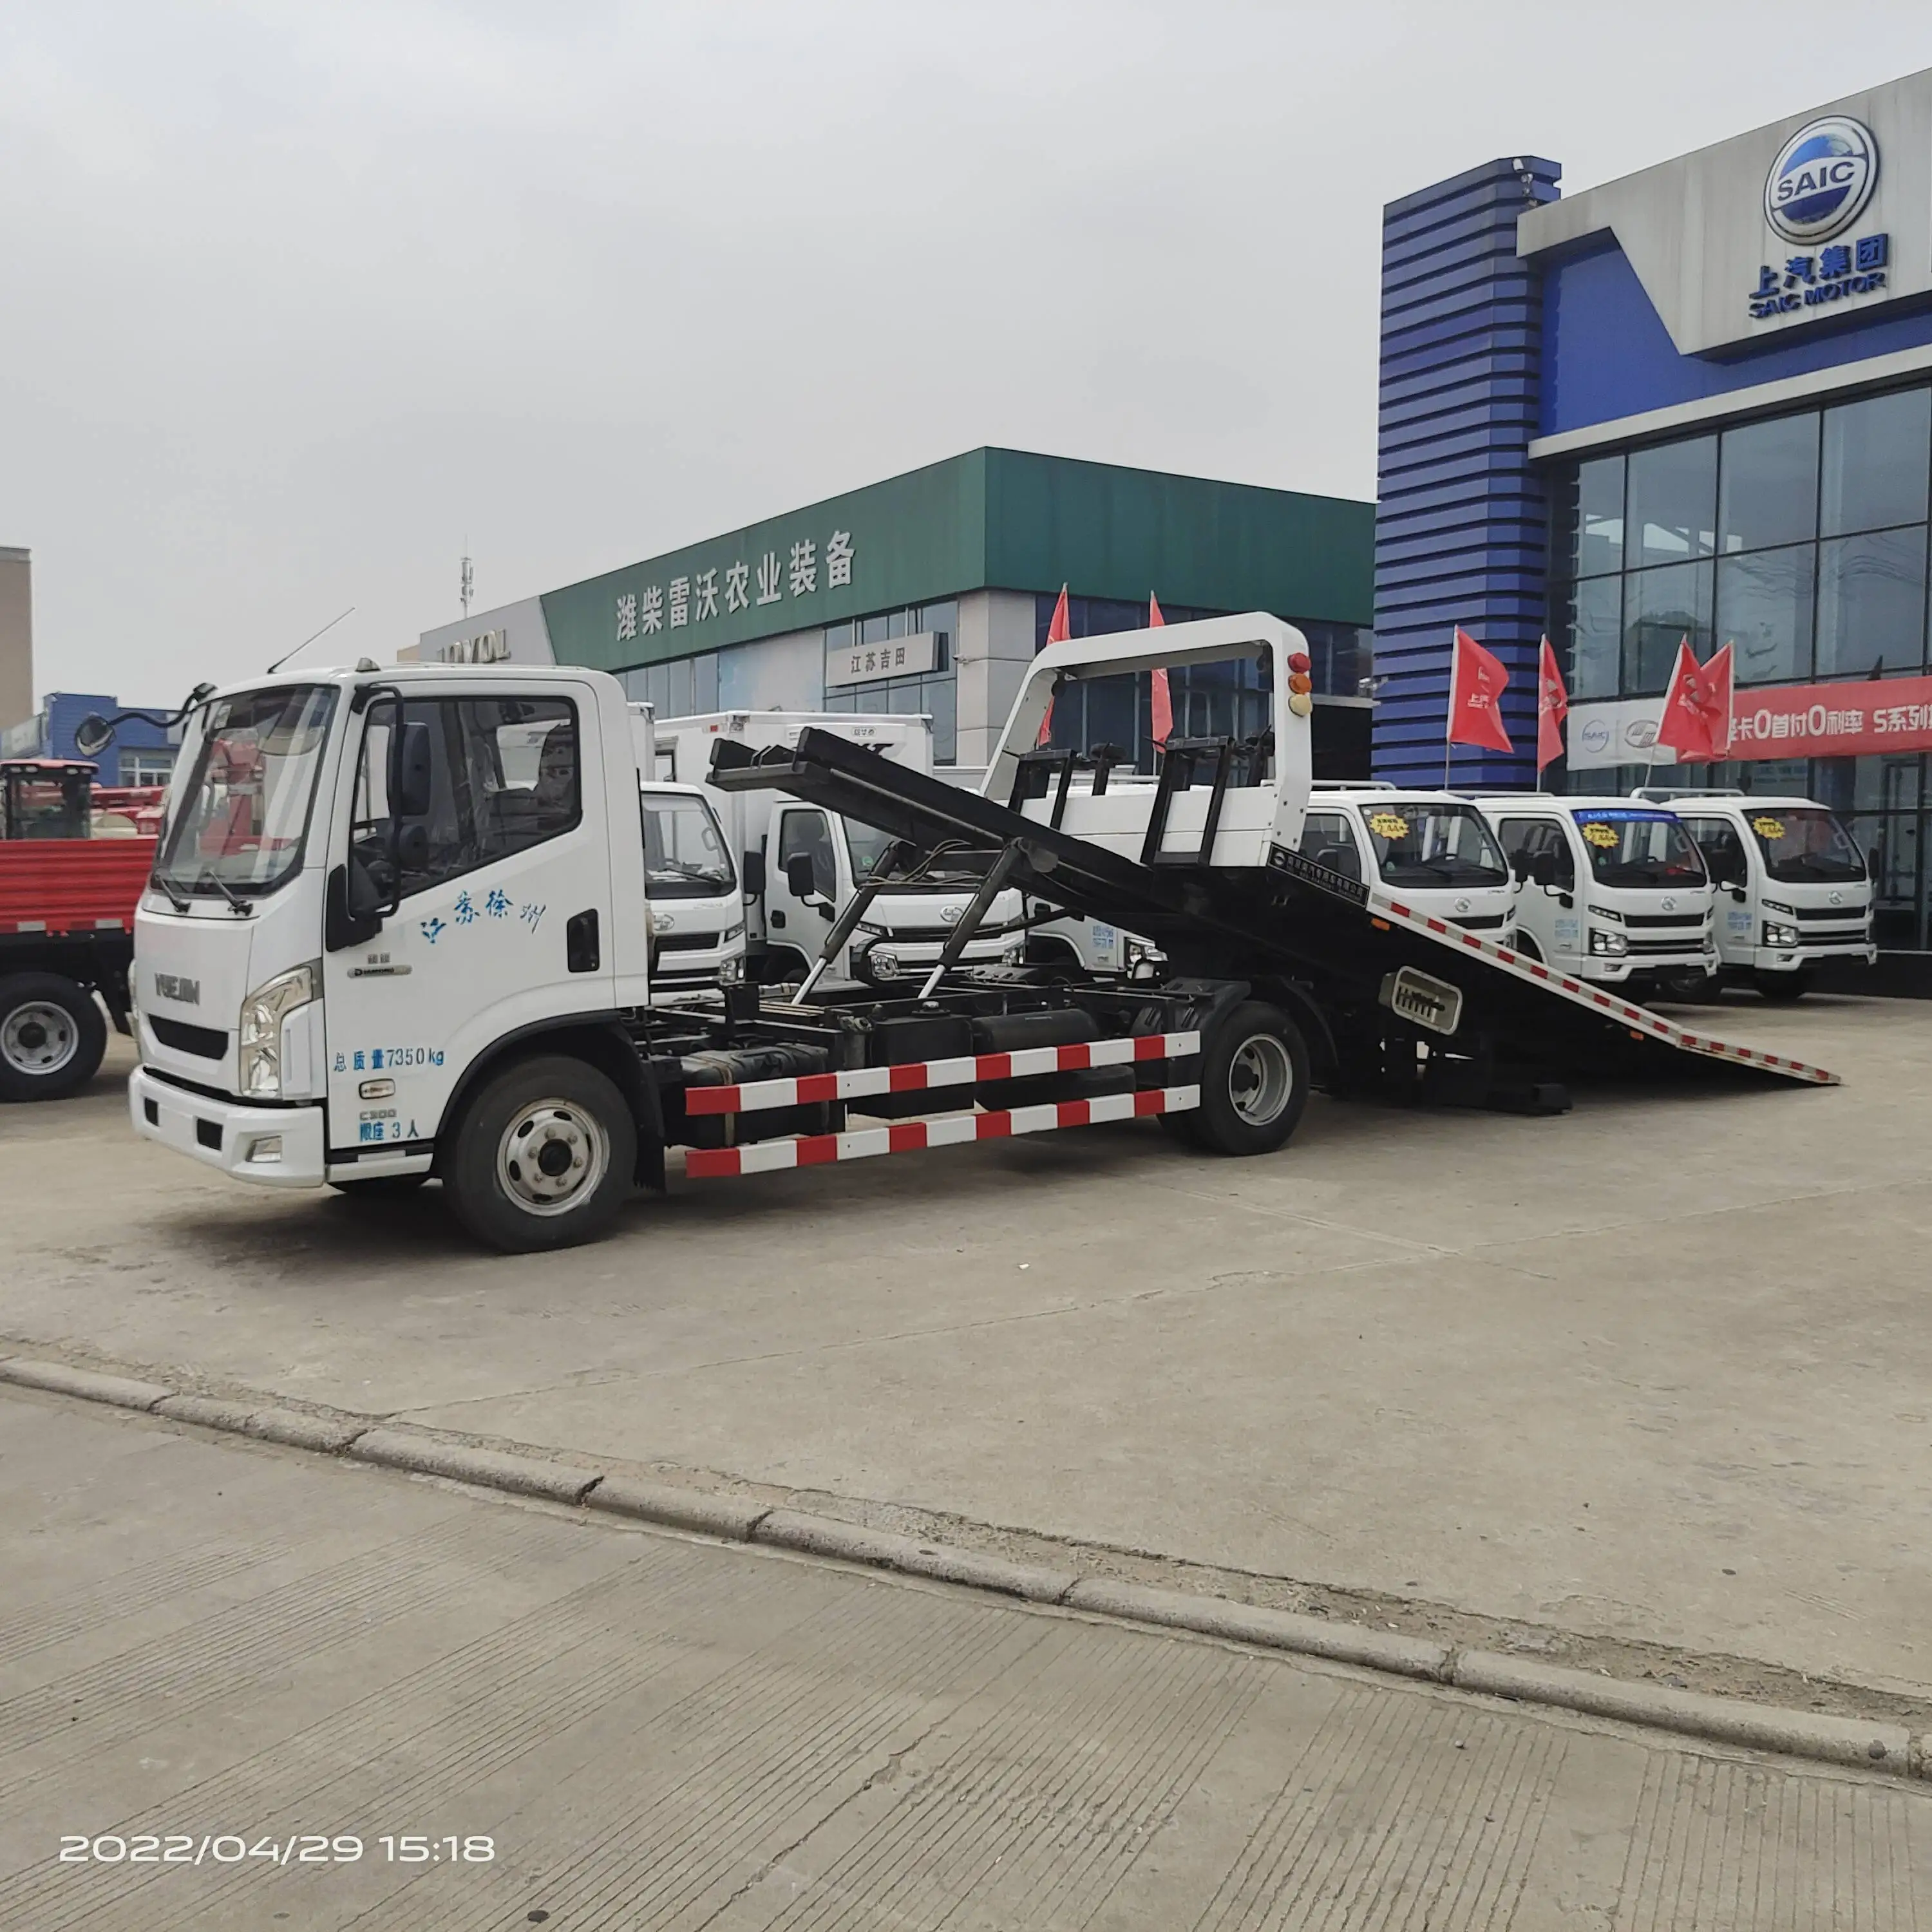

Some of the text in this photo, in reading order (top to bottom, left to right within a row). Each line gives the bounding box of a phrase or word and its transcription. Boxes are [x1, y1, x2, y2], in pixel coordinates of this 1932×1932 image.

[1777, 162, 1855, 201] SAIC
[1748, 233, 1889, 300] 上汽集团
[1748, 272, 1887, 319] SAIC MOTOR
[616, 530, 856, 642] 潍柴雷沃农业装备
[851, 647, 905, 674] 江苏吉田
[1872, 703, 1932, 734] S系列
[420, 889, 547, 944] 江苏徐州
[359, 1108, 397, 1120] C300
